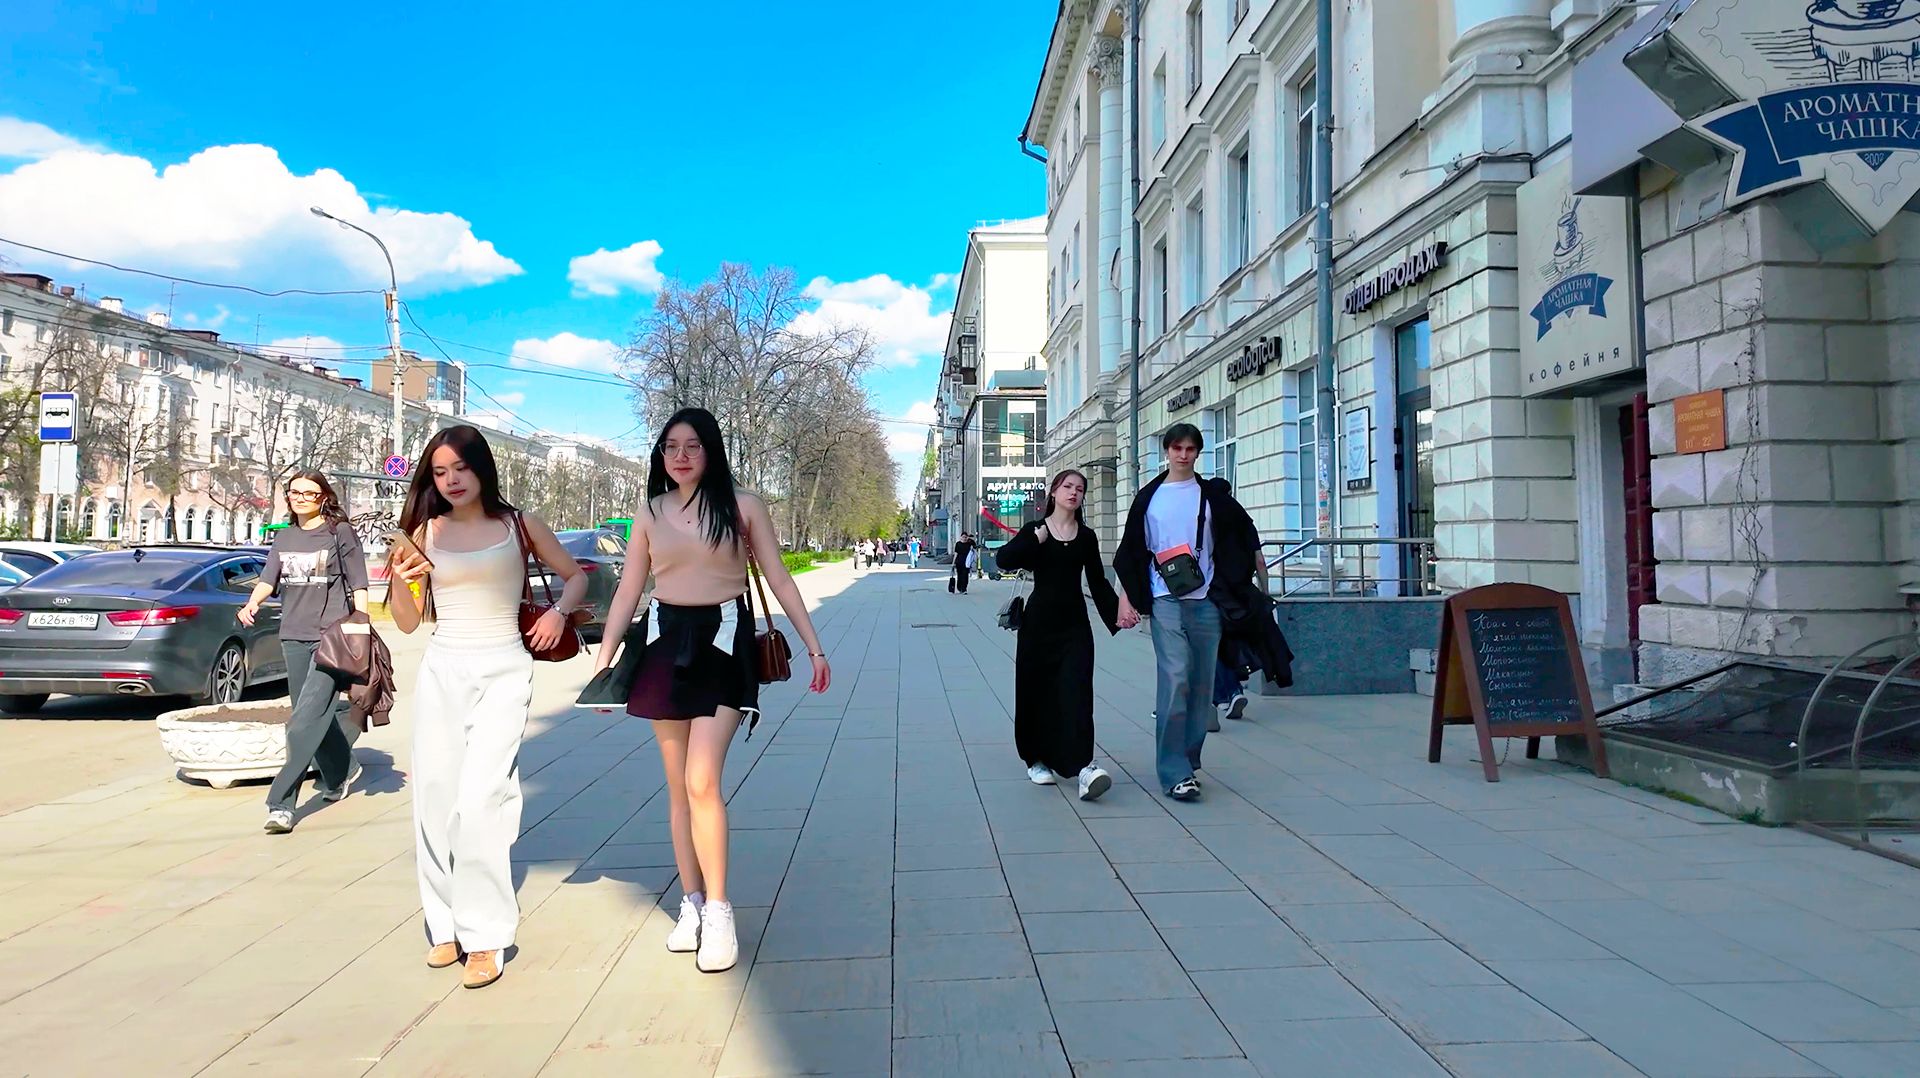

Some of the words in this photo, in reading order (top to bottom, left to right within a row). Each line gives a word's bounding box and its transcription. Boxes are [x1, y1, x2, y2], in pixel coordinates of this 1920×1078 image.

[1344, 278, 1380, 315] ОТДЕЛ
[1380, 243, 1442, 297] ПРОДАЖ
[1547, 278, 1592, 304] АРОМАТНАЯ
[1555, 291, 1584, 309] ЧАШКА
[1227, 337, 1280, 381] ecologica
[1529, 347, 1620, 384] кофейня
[1020, 482, 1047, 490] захо
